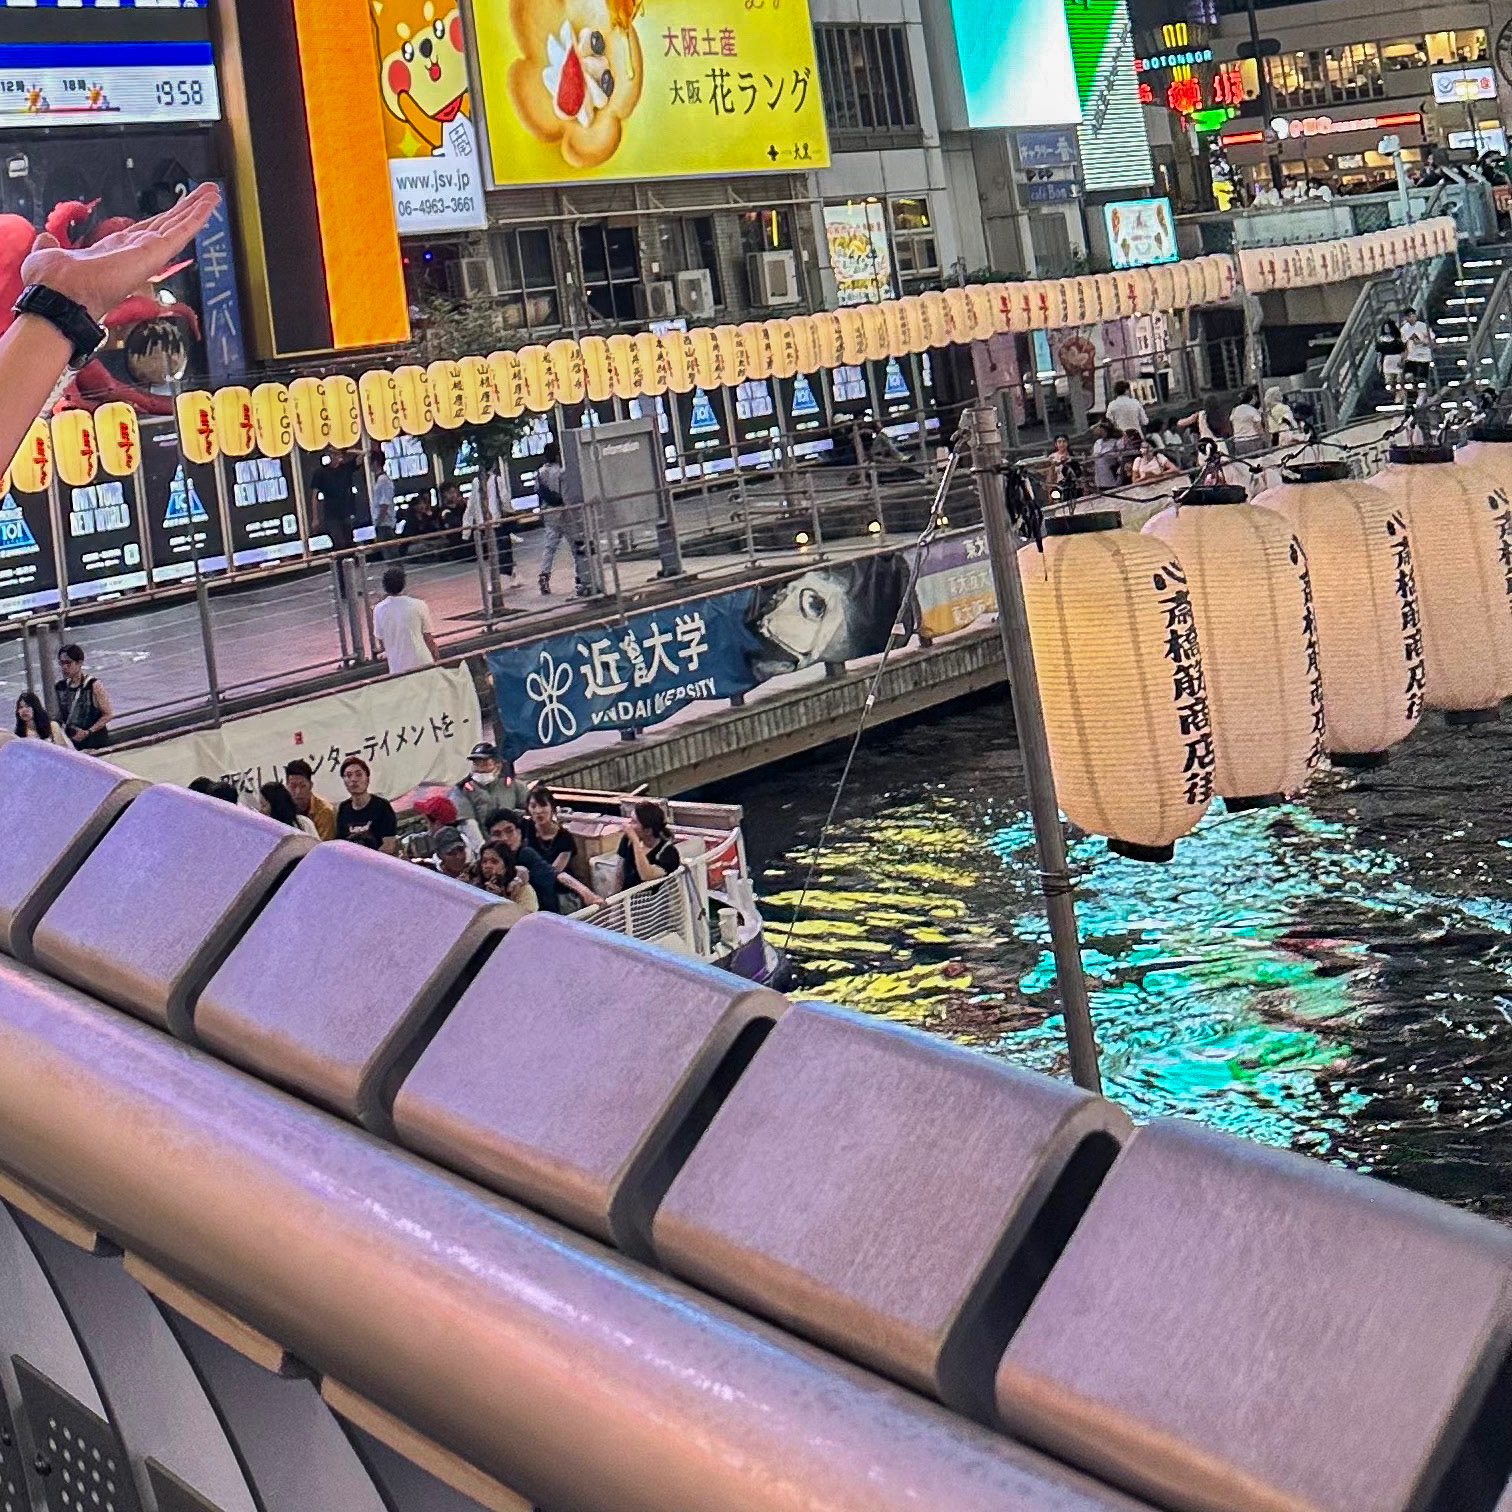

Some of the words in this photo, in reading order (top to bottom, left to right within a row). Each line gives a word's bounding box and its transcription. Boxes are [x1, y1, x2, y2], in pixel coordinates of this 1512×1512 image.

[662, 26, 737, 57] 大阪土産
[0, 79, 25, 94] 12時
[62, 78, 87, 93] 18時
[669, 79, 702, 105] 大阪
[705, 65, 812, 116] 花ラング
[395, 168, 470, 190] www.jsv.jp
[398, 196, 475, 217] 06-4963-3661
[202, 210, 238, 366] ンギンバー
[1, 523, 24, 540] 101
[1153, 561, 1215, 806] 心斎橋筋商店街
